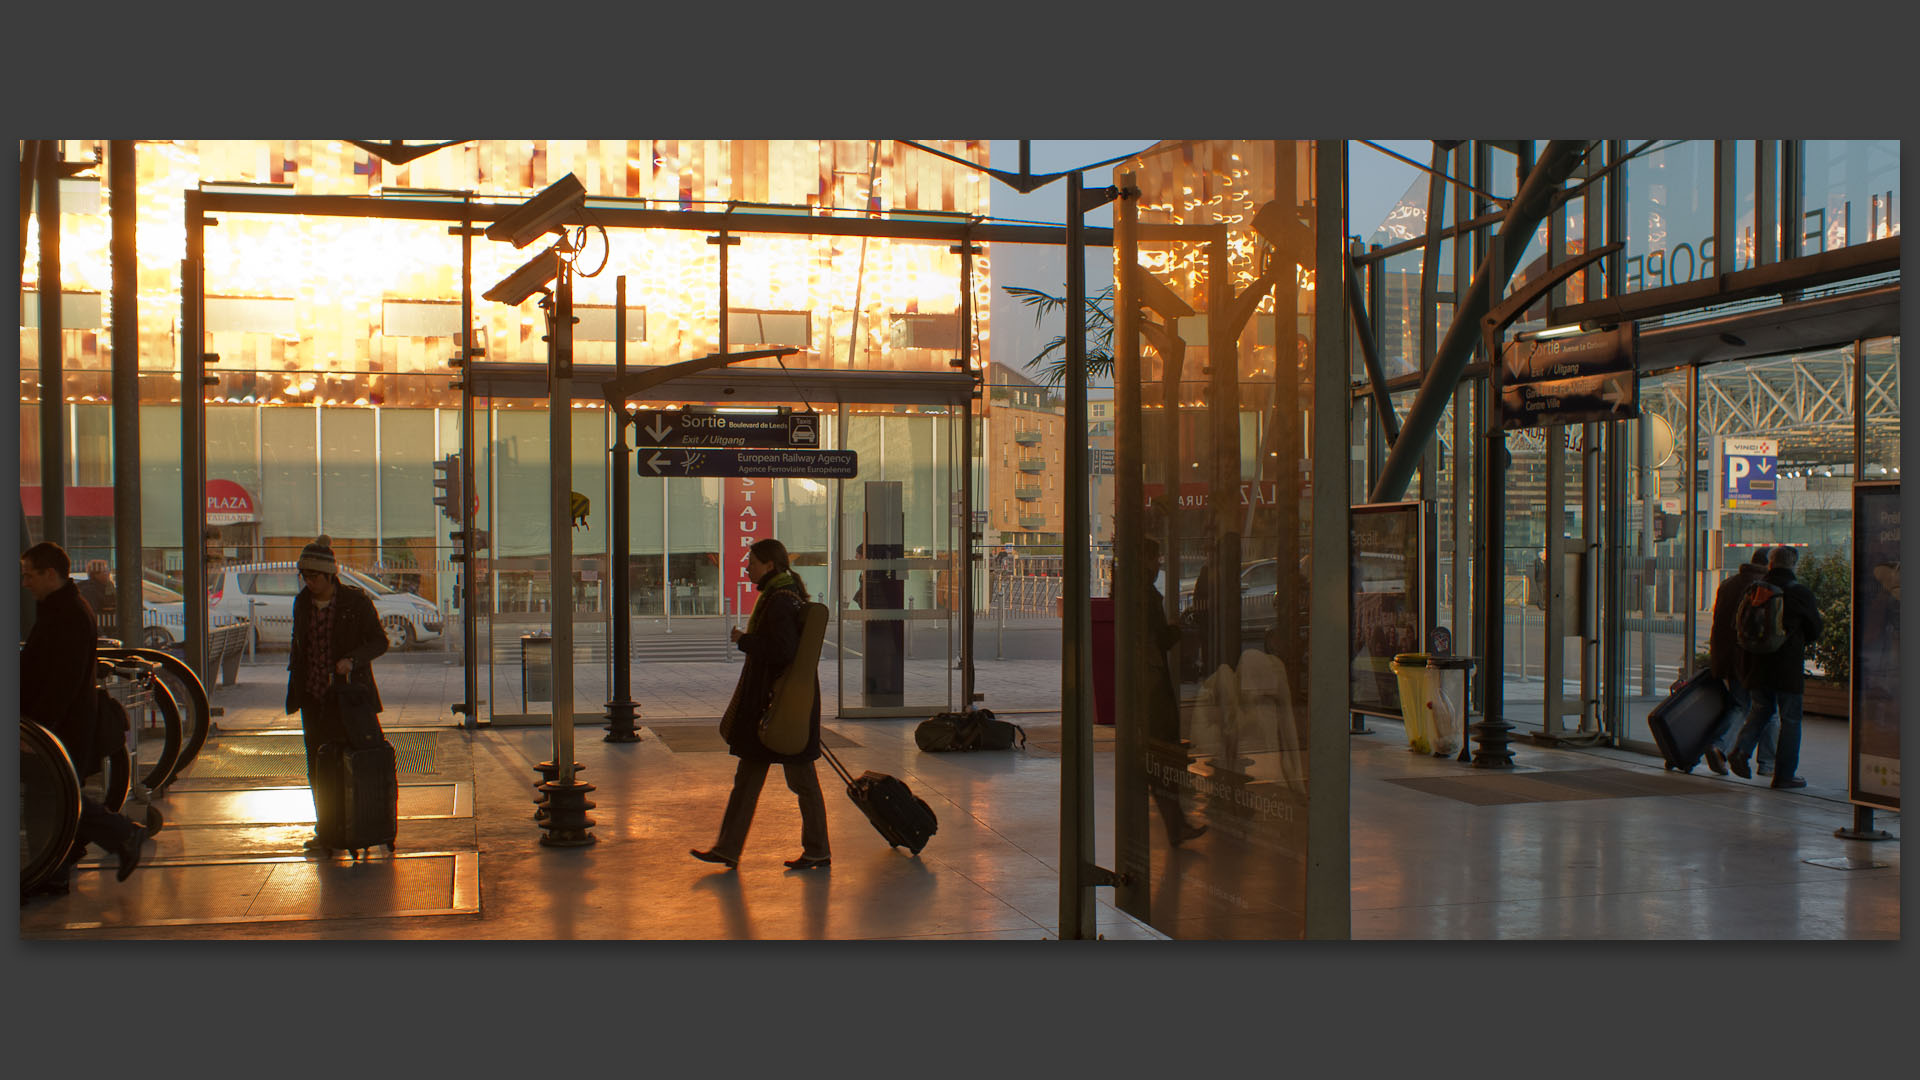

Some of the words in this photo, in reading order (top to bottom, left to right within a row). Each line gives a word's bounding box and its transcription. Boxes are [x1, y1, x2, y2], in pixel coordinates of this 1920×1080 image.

[1530, 339, 1560, 356] Sortie
[1553, 362, 1579, 376] Uitgang
[681, 414, 726, 428] Sortie
[729, 421, 759, 430] Boulevard
[760, 422, 768, 430] de
[769, 422, 788, 430] Leeds
[682, 434, 699, 445] Exit
[710, 434, 745, 446] Uitgang
[737, 453, 780, 465] European
[782, 453, 815, 464] Railway
[818, 454, 851, 465] Agency
[739, 466, 766, 474] Agence
[767, 466, 806, 474] Ferroviaire
[807, 465, 852, 474] Européenne
[1729, 456, 1750, 488] P
[207, 496, 248, 509] PLAZA
[740, 477, 757, 593] STAURANT
[1145, 751, 1161, 777] Un
[1162, 765, 1192, 787] grand
[1195, 774, 1232, 801] musée
[1234, 788, 1294, 824] européen
